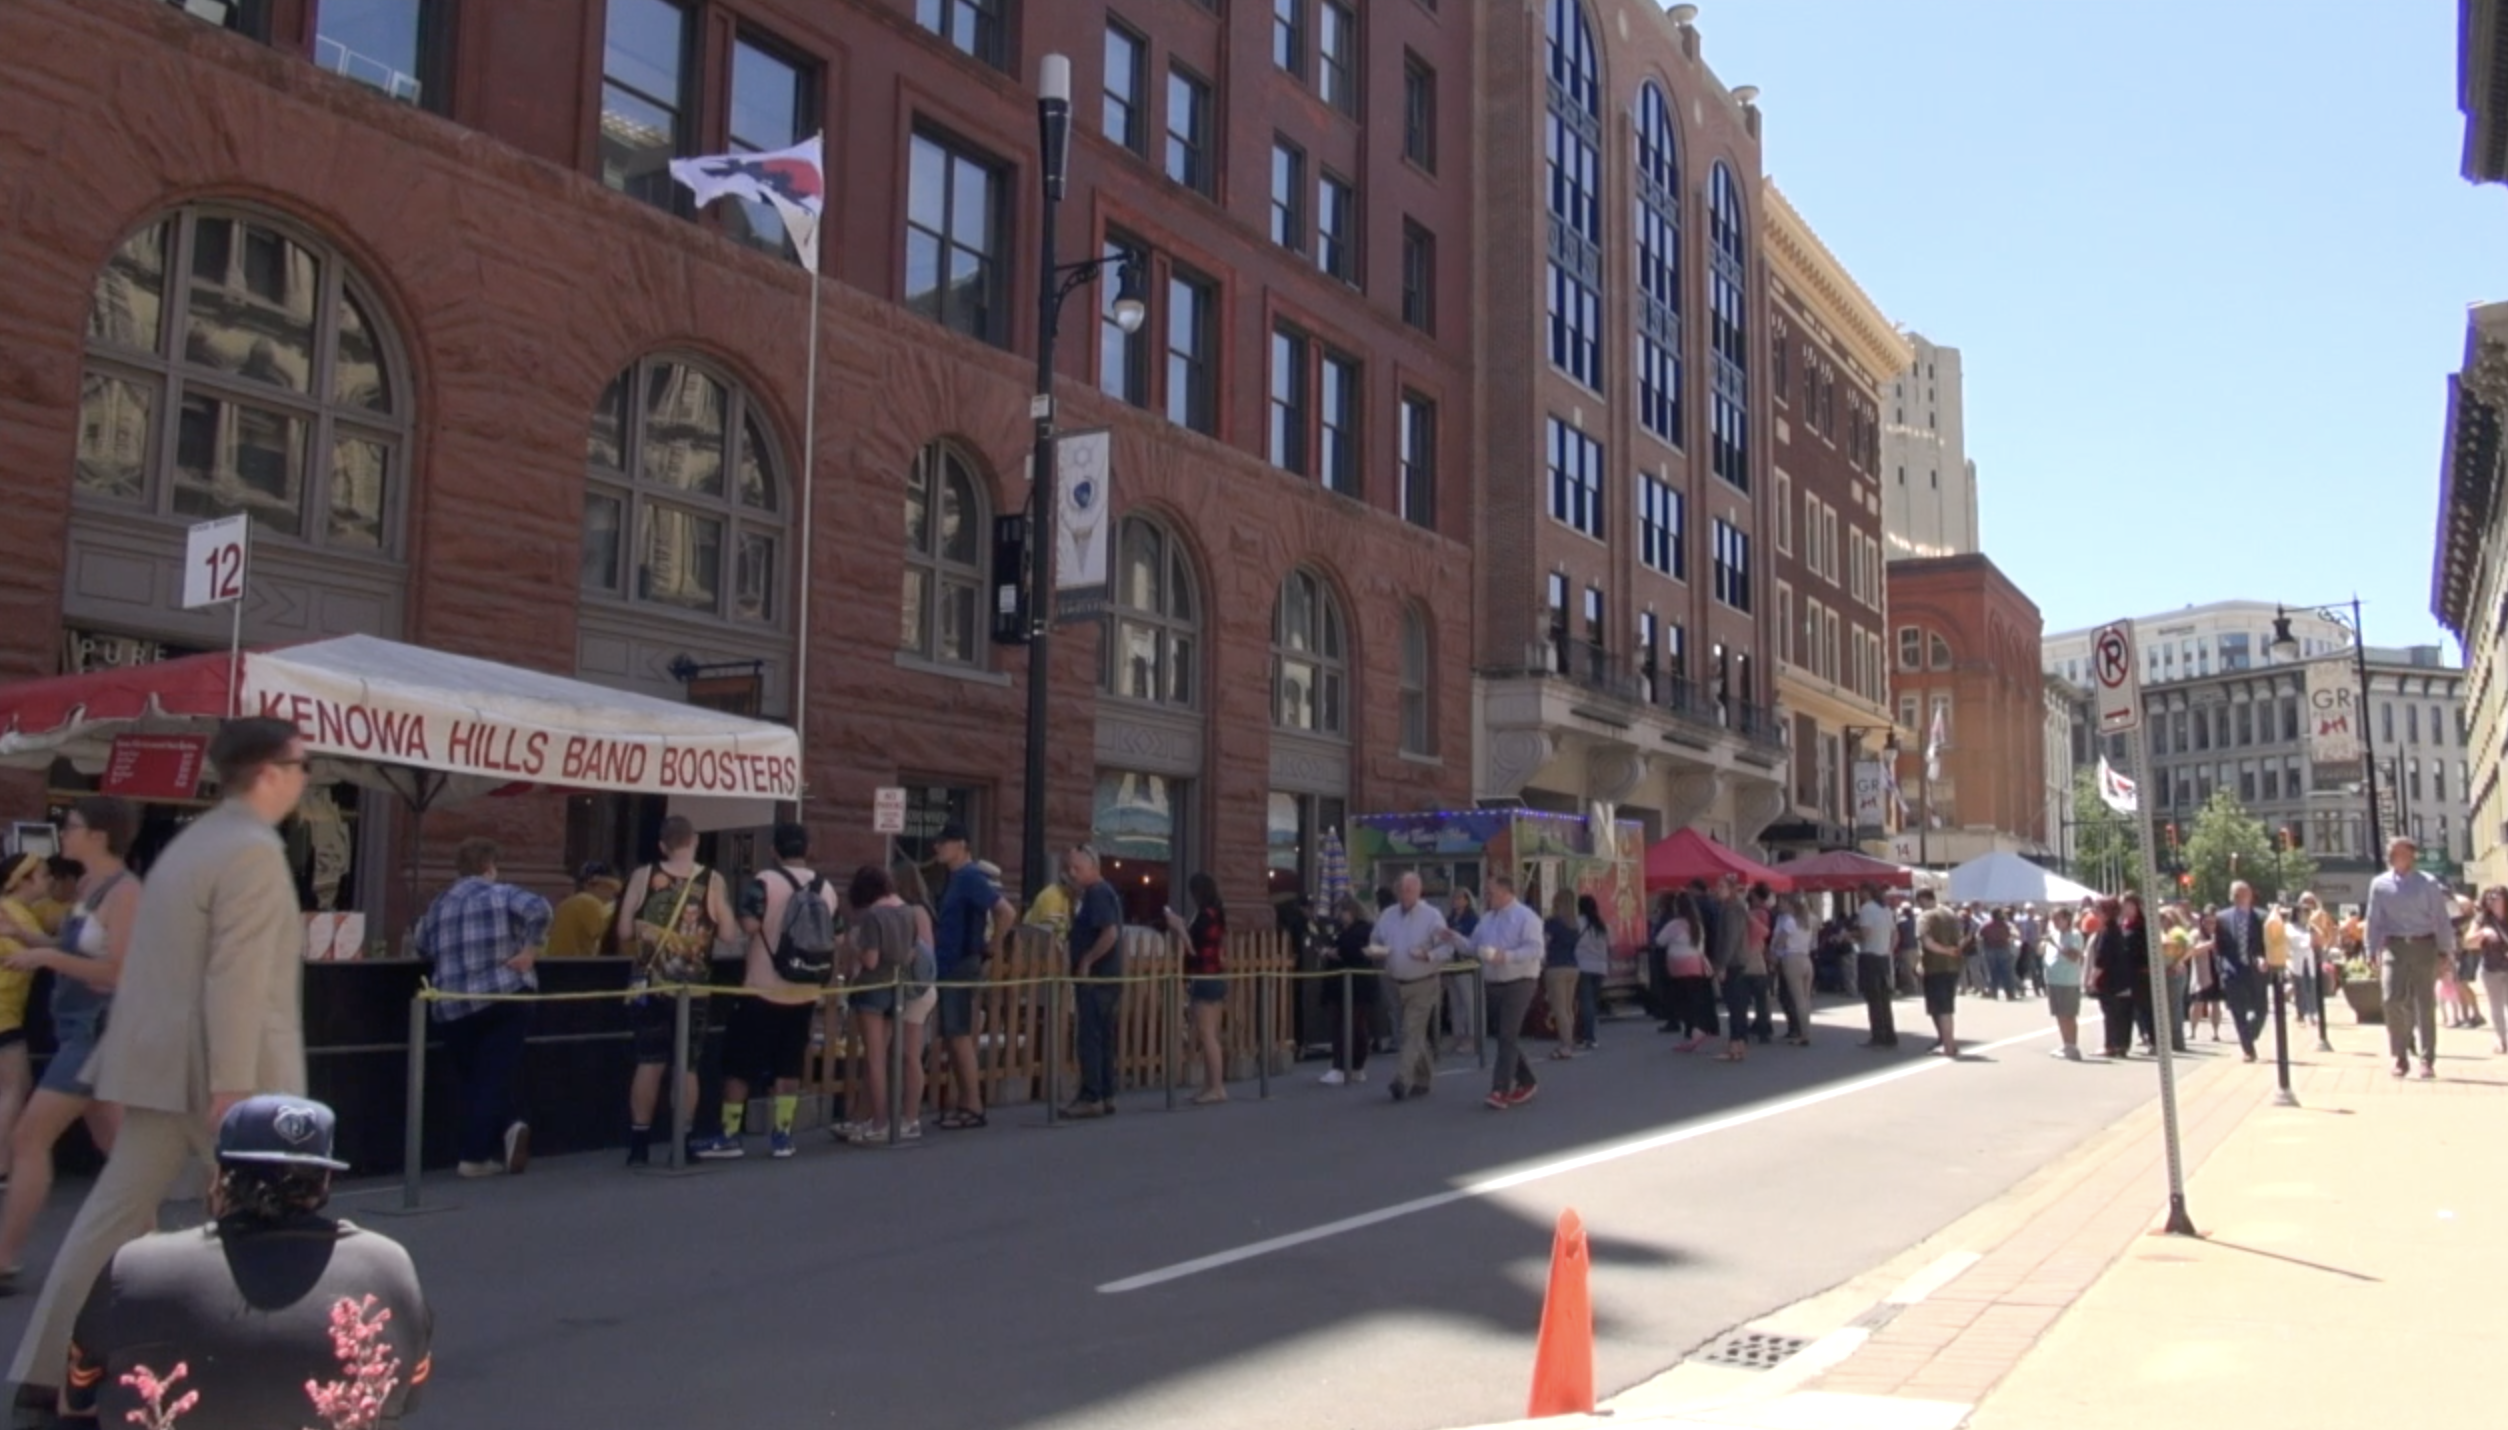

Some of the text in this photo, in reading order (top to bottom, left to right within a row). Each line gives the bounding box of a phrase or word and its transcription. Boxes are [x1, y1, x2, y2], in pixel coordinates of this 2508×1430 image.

[205, 542, 242, 600] 12
[2311, 687, 2352, 710] GR
[259, 690, 798, 796] KENOWA HILLS BAND BOOSTERS
[1895, 843, 1910, 857] 14
